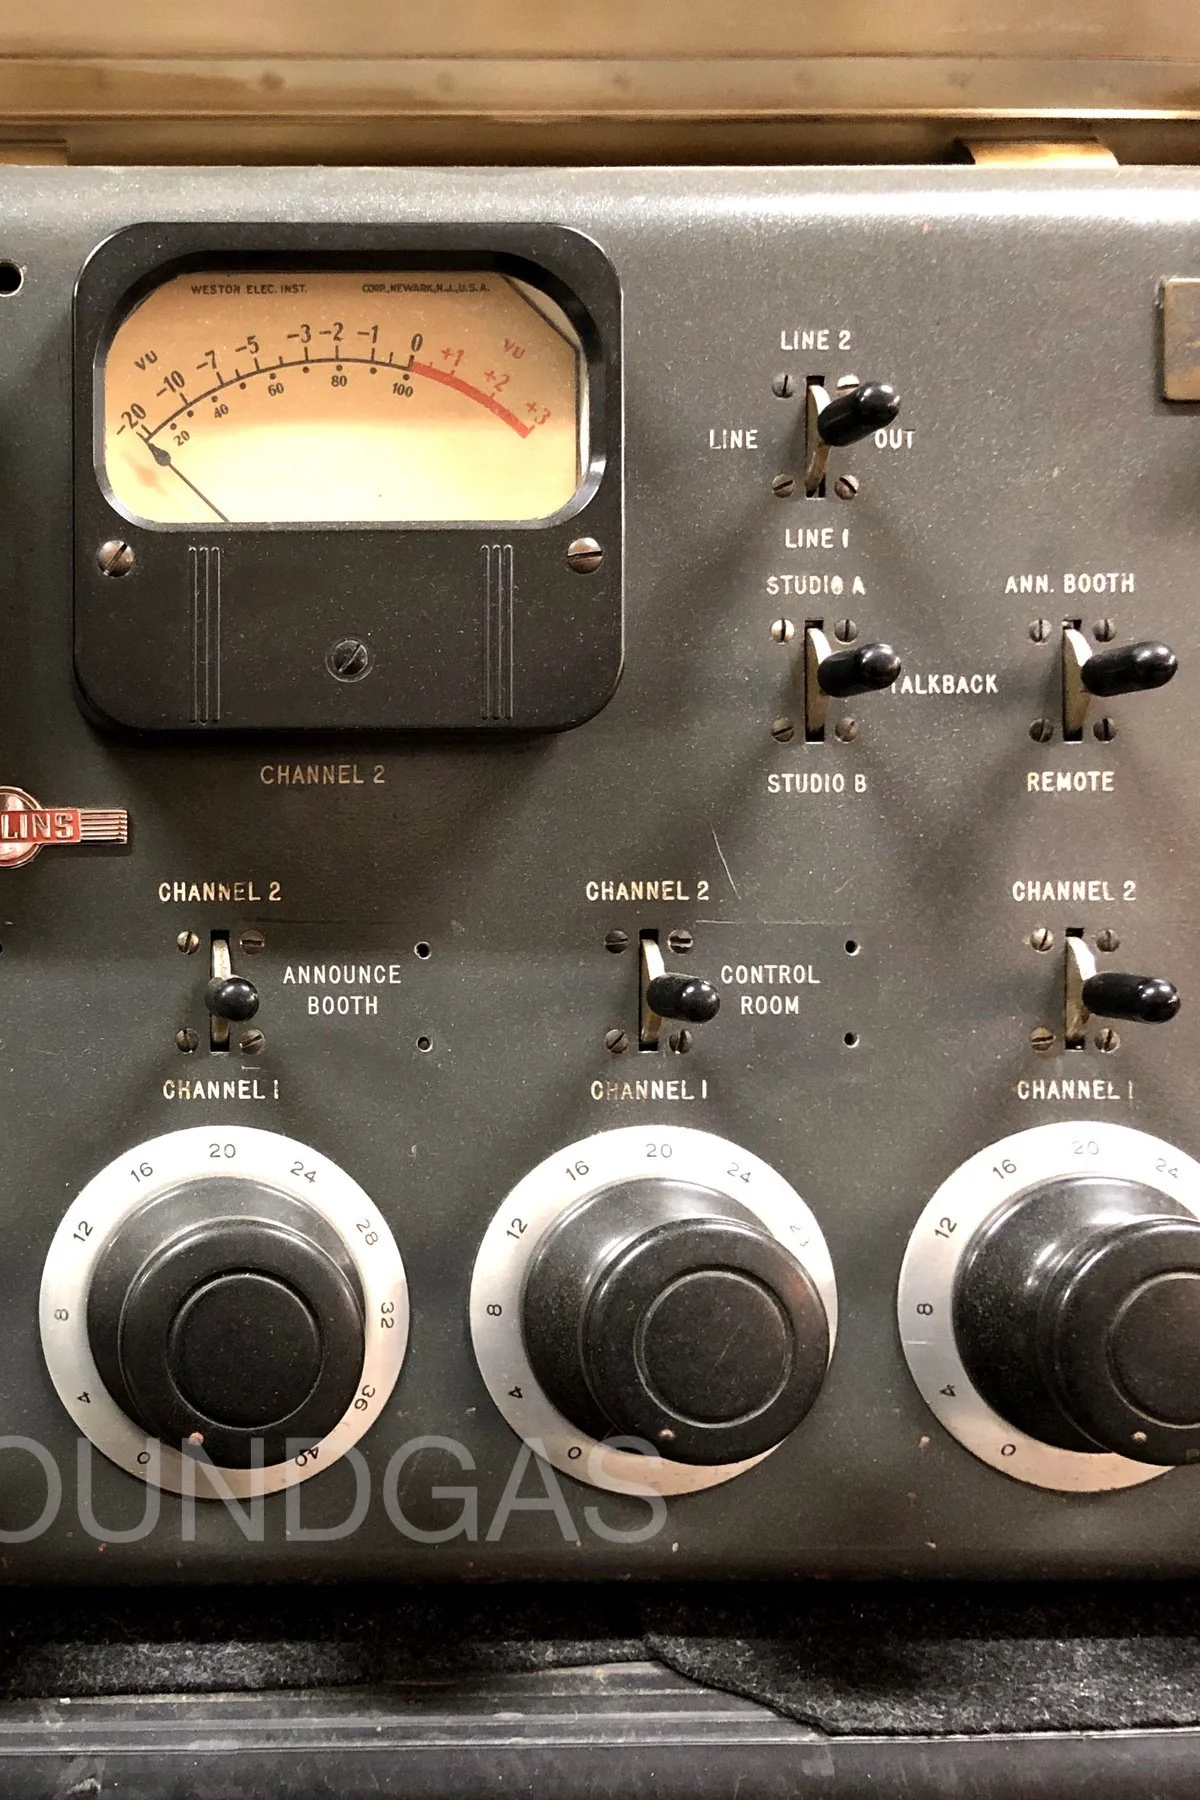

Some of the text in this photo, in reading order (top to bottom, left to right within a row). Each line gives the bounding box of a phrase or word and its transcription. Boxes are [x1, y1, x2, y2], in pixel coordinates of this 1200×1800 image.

[190, 284, 308, 294] WESTON ELEC. INST.
[502, 337, 526, 359] VU
[780, 330, 851, 351] LINE 2
[133, 350, 159, 373] VU
[410, 333, 424, 352] 0
[440, 346, 464, 367] +1
[484, 368, 511, 392] +2
[524, 400, 552, 427] +3
[173, 374, 414, 448] 20 40 60 80 100
[709, 428, 916, 449] LINE OUT
[784, 528, 834, 549] LINE
[765, 575, 866, 595] STUDIO A
[1004, 573, 1135, 594] ANN. BOOTH
[260, 765, 386, 785] CHANNEL 2
[767, 774, 867, 794] STUDIO B
[1026, 771, 1115, 792] REMOTE
[158, 882, 281, 901] CHANNEL 2
[585, 881, 709, 901] CHANNEL 2
[1012, 881, 1136, 901] CHANNEL 2
[283, 965, 401, 985] ANNOUNCE
[721, 965, 820, 984] CONTROL
[308, 995, 378, 1015] BOOTH
[741, 996, 799, 1015] ROOM
[162, 1079, 265, 1099] CHANNEL
[590, 1080, 694, 1101] CHANNEL
[1017, 1080, 1120, 1101] CHANNEL
[646, 1143, 672, 1159] 20
[566, 1161, 589, 1181] 16
[727, 1162, 752, 1183] 24
[506, 1218, 528, 1240] 12
[54, 1143, 394, 1468] 0 4 8 12 16 20 24 28 32 36 40
[917, 1140, 1178, 1456] 0 4 8 12 16 20 24
[487, 1304, 502, 1317] 8
[508, 1386, 523, 1399] 4
[568, 1446, 581, 1459] 0
